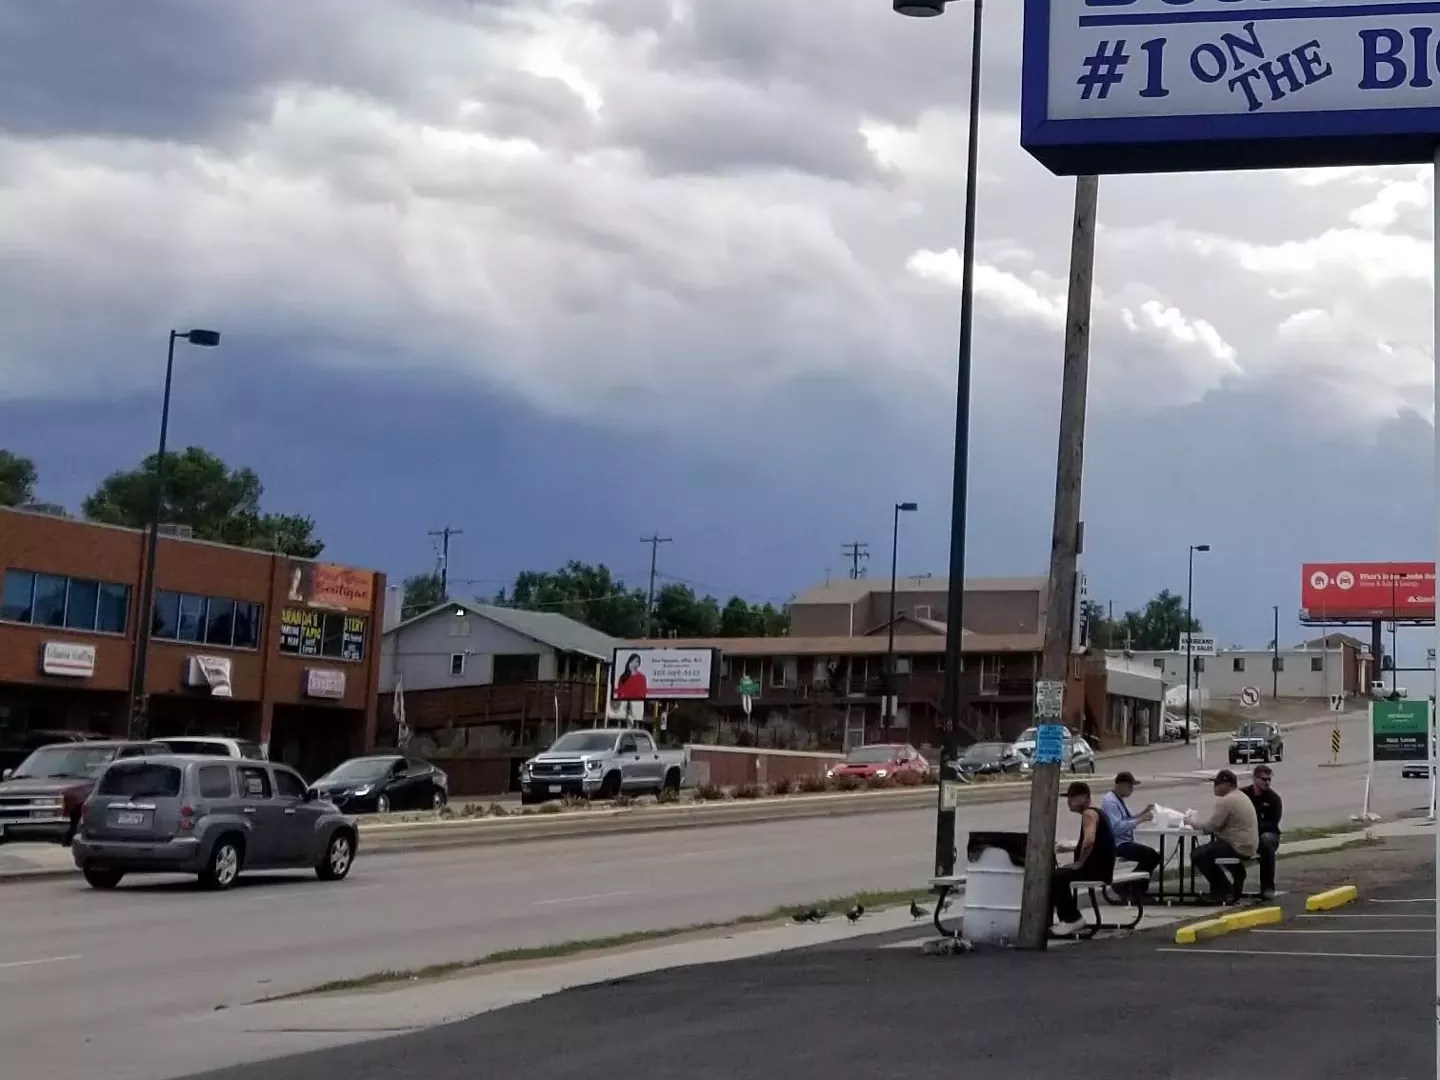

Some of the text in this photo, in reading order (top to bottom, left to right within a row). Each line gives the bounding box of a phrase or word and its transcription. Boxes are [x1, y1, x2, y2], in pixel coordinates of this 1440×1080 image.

[1077, 38, 1169, 100] #1
[1190, 22, 1264, 83] ON
[1229, 40, 1332, 111] THE
